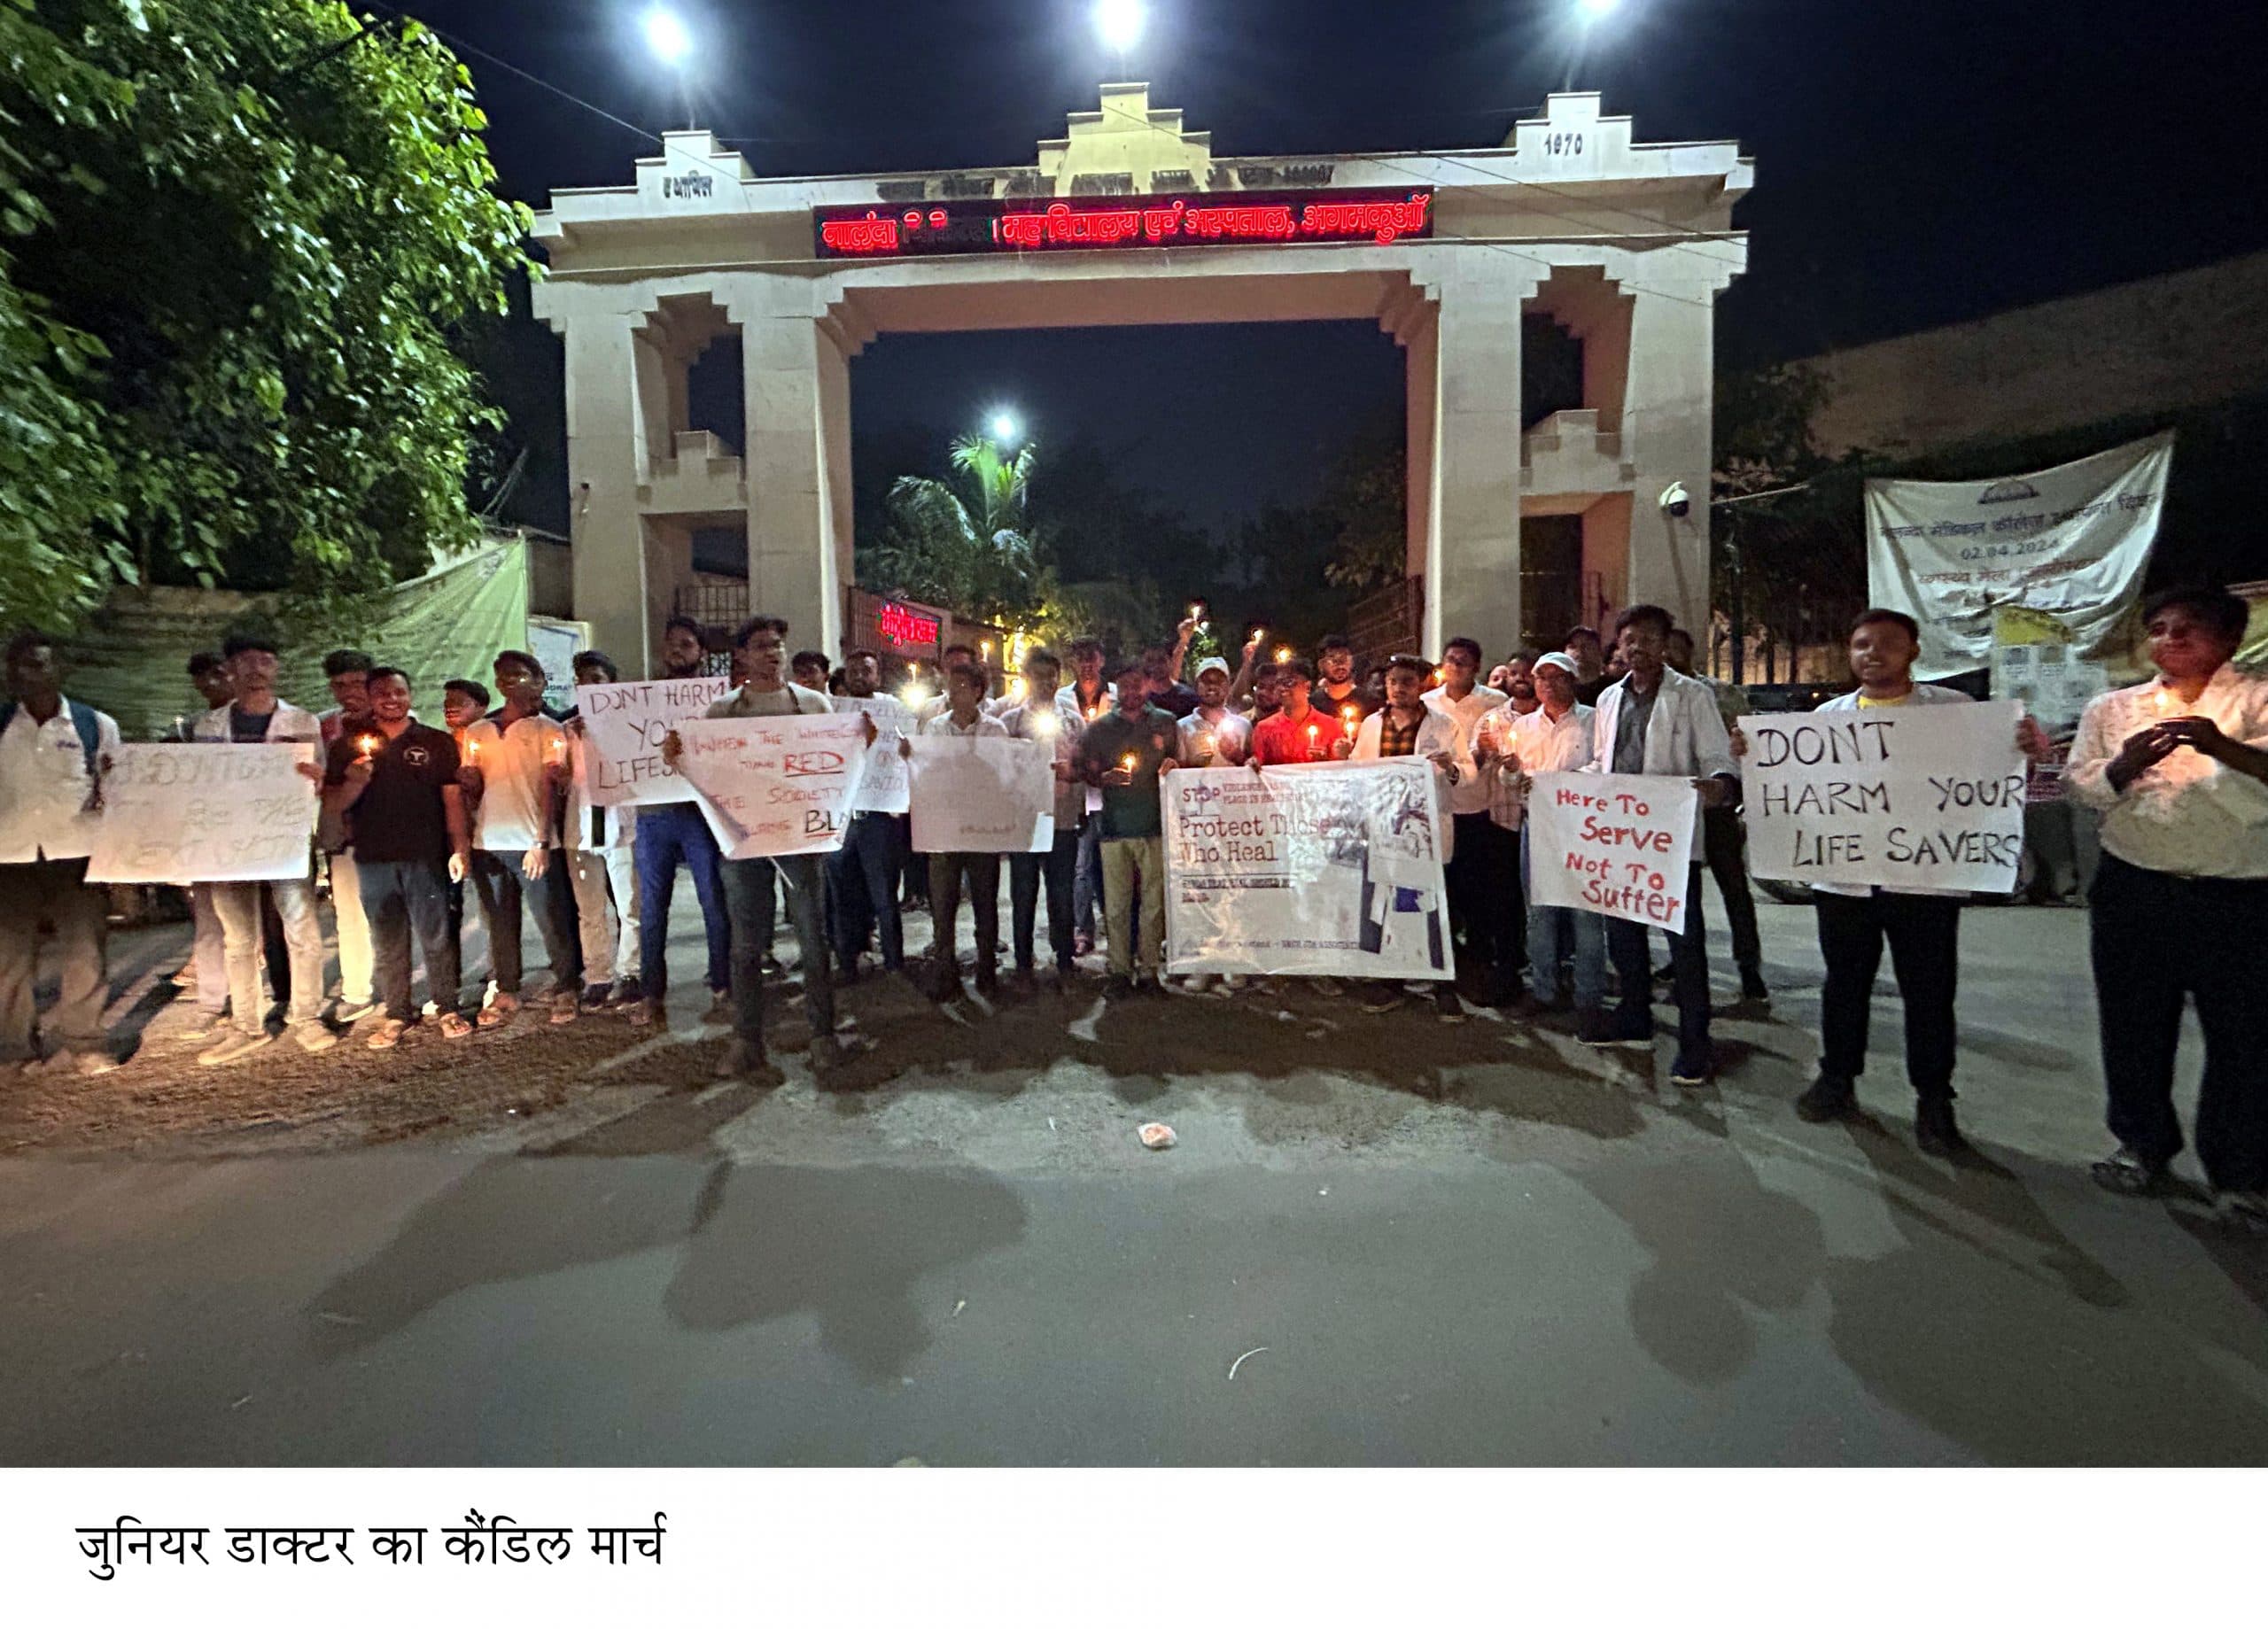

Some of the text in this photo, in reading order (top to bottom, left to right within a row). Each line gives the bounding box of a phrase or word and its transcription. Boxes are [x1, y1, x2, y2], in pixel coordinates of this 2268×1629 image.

[1544, 133, 1583, 156] 1970
[821, 209, 898, 248] नालंदा
[1144, 200, 1184, 239] एवं
[589, 681, 726, 715] DONT HARM
[755, 730, 784, 746] THE
[1757, 721, 1895, 768] DONT
[784, 750, 845, 774] RED
[1557, 788, 1650, 817] Here To
[1762, 774, 2025, 818] HARM YOUR
[1178, 813, 1330, 839] Protect Those
[1580, 816, 1673, 853] Serve
[1227, 841, 1278, 862] Heal
[1792, 826, 2022, 867] LIFE SAVERS
[1565, 852, 1665, 890] Not To
